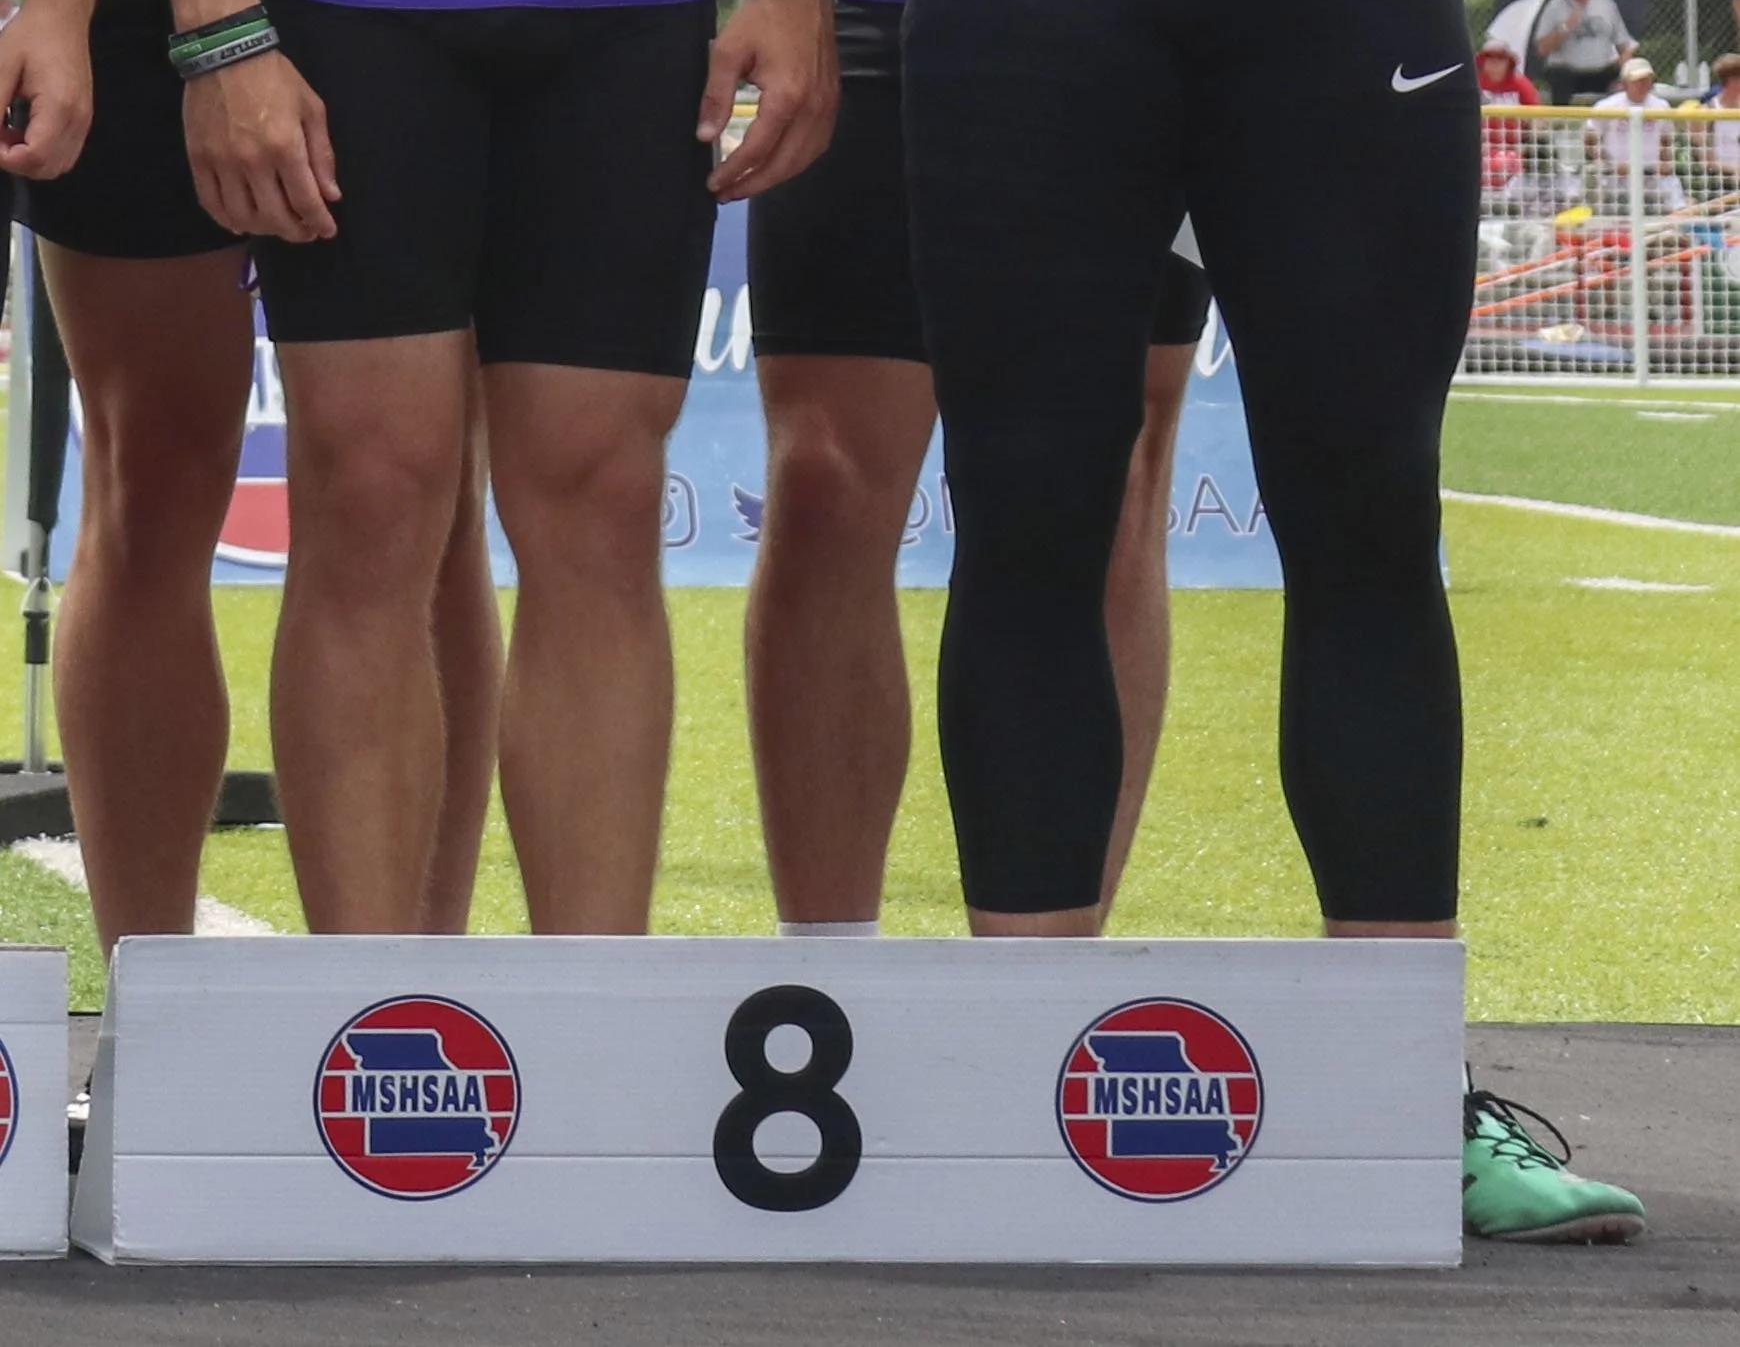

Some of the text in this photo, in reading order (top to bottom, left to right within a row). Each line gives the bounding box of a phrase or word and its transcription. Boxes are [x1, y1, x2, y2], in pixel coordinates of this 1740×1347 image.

[351, 1074, 481, 1114] MSHSAA
[713, 985, 862, 1212] 8
[1093, 1077, 1224, 1116] MSHSAA
